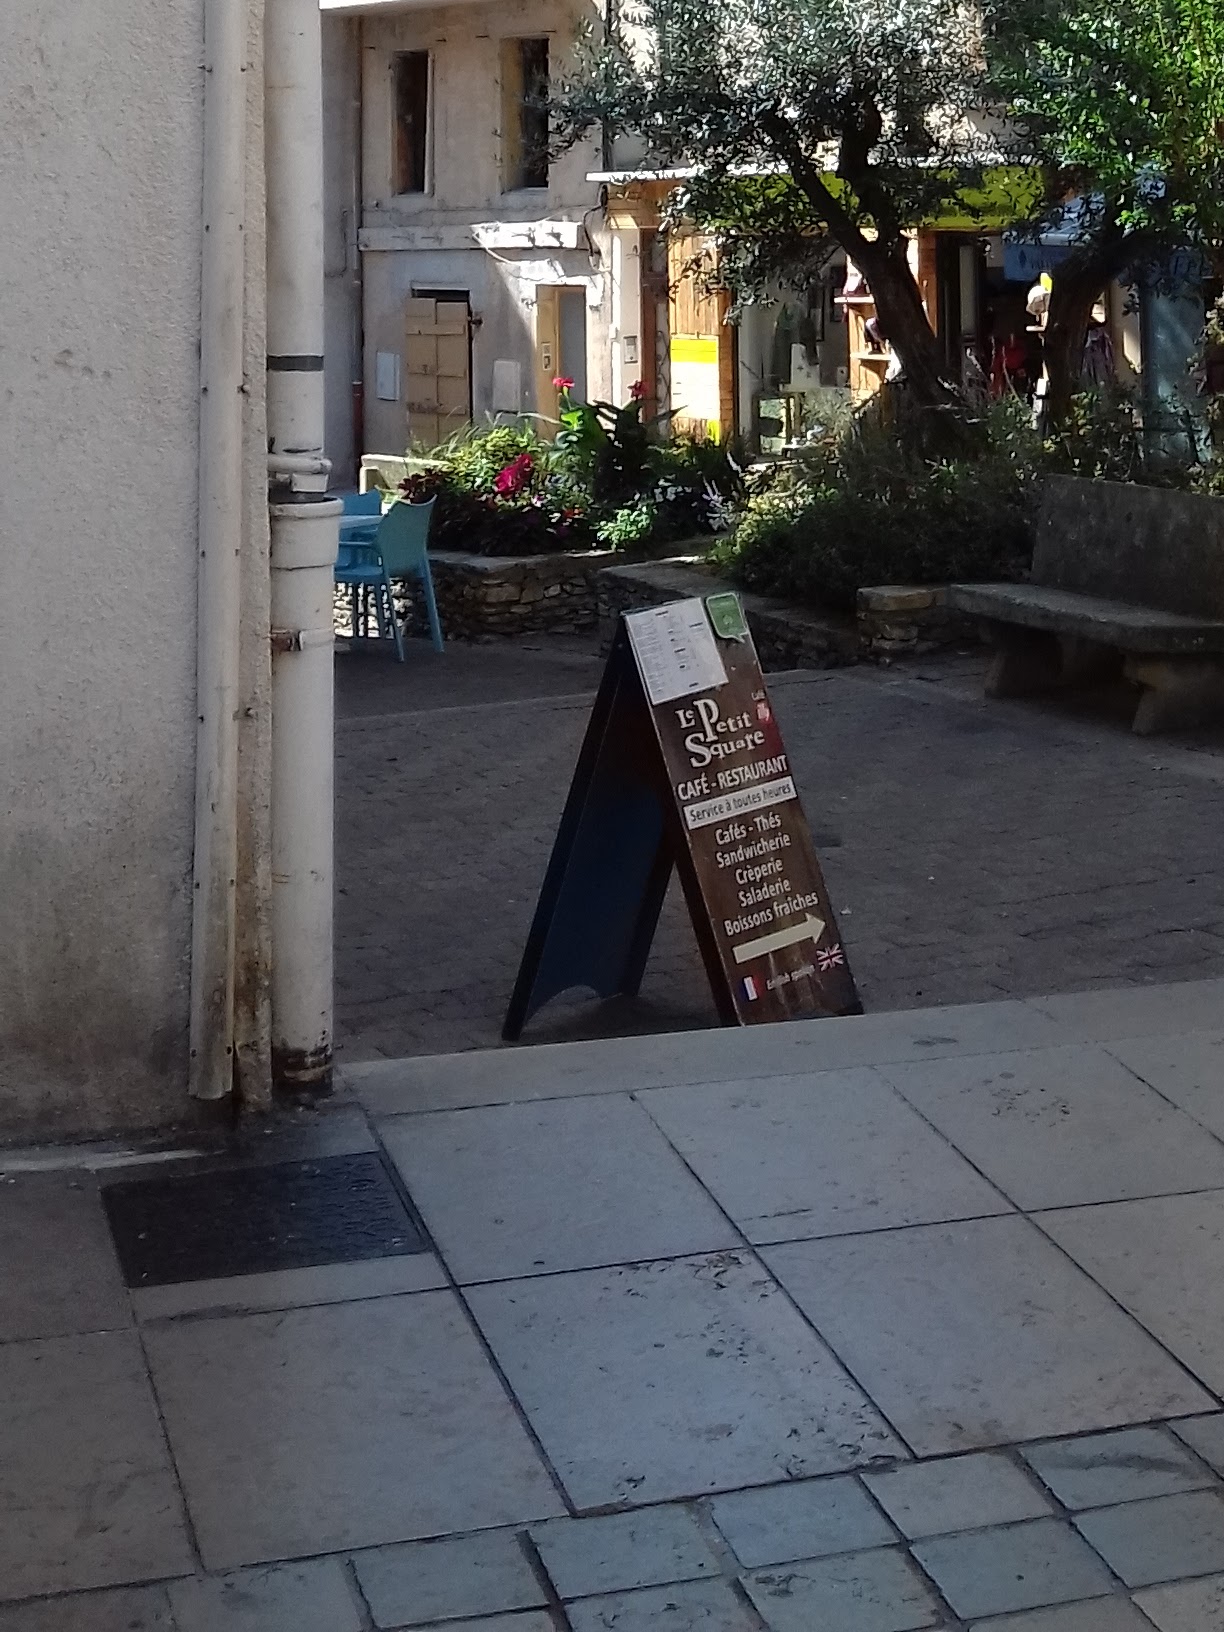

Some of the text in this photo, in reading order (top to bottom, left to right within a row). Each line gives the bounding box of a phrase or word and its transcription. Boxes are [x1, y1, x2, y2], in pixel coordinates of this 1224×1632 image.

[675, 708, 696, 729] Le
[693, 698, 752, 743] Petit
[685, 730, 765, 768] Square
[678, 772, 711, 801] CAFÉ
[717, 754, 788, 789] RESTAURANT
[690, 802, 724, 822] Service
[732, 792, 761, 808] toutes
[762, 784, 791, 799] heures
[715, 822, 747, 845] Cafés
[753, 812, 782, 832] Thés
[716, 832, 791, 868] Sandwicherie
[738, 878, 791, 907] Saladerie
[724, 908, 774, 936] Boissons
